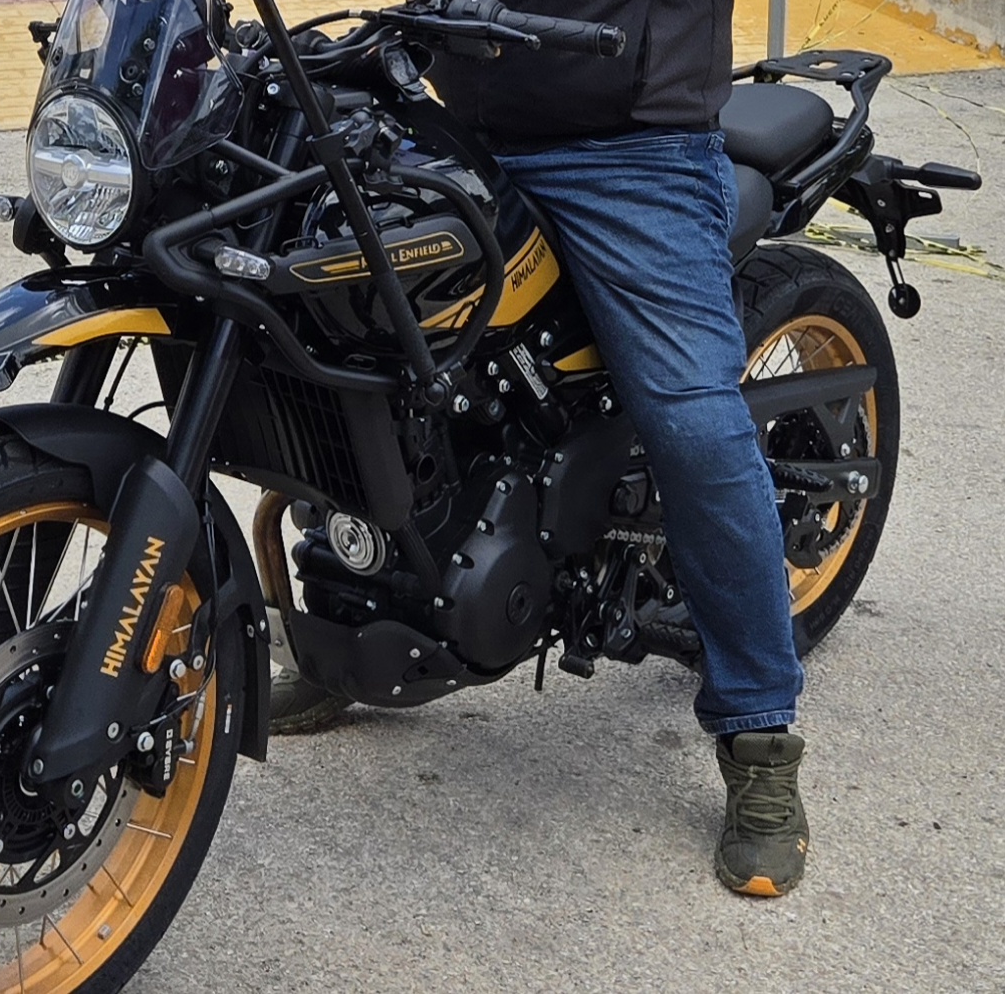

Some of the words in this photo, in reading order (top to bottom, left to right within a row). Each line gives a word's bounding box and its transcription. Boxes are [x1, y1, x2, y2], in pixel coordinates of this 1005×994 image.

[398, 242, 441, 263] ENFIELD
[510, 238, 547, 293] HIMALAYAN
[99, 536, 166, 678] HIMALAYAN
